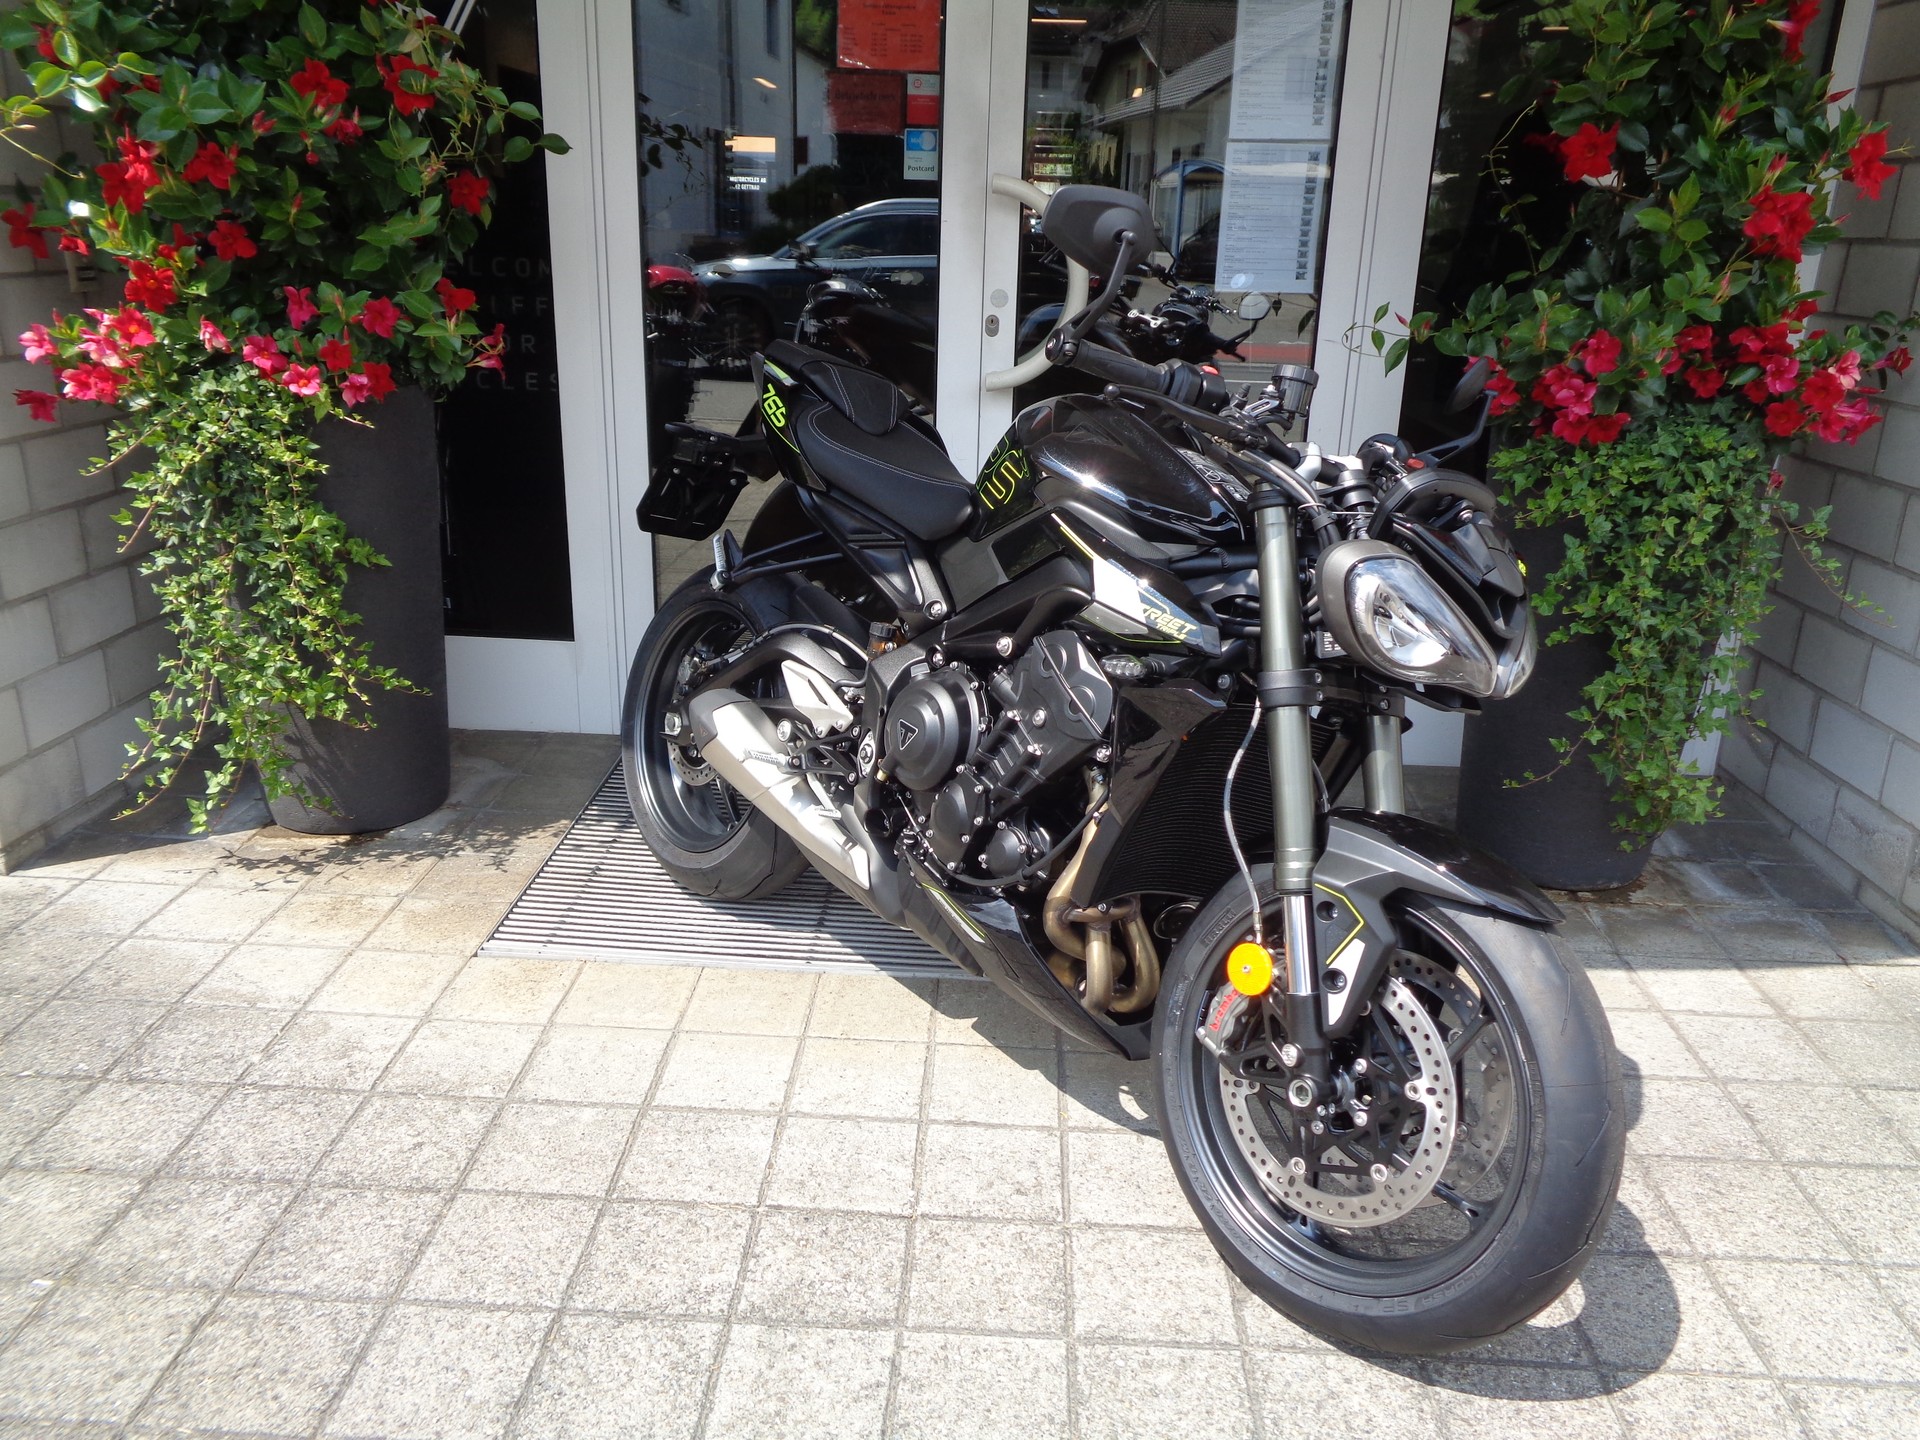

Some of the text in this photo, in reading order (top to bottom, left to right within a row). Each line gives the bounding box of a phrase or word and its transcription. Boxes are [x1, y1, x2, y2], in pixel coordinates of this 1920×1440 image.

[907, 164, 935, 172] Postcard
[762, 383, 786, 427] 765
[1155, 623, 1188, 640] TRIPLE
